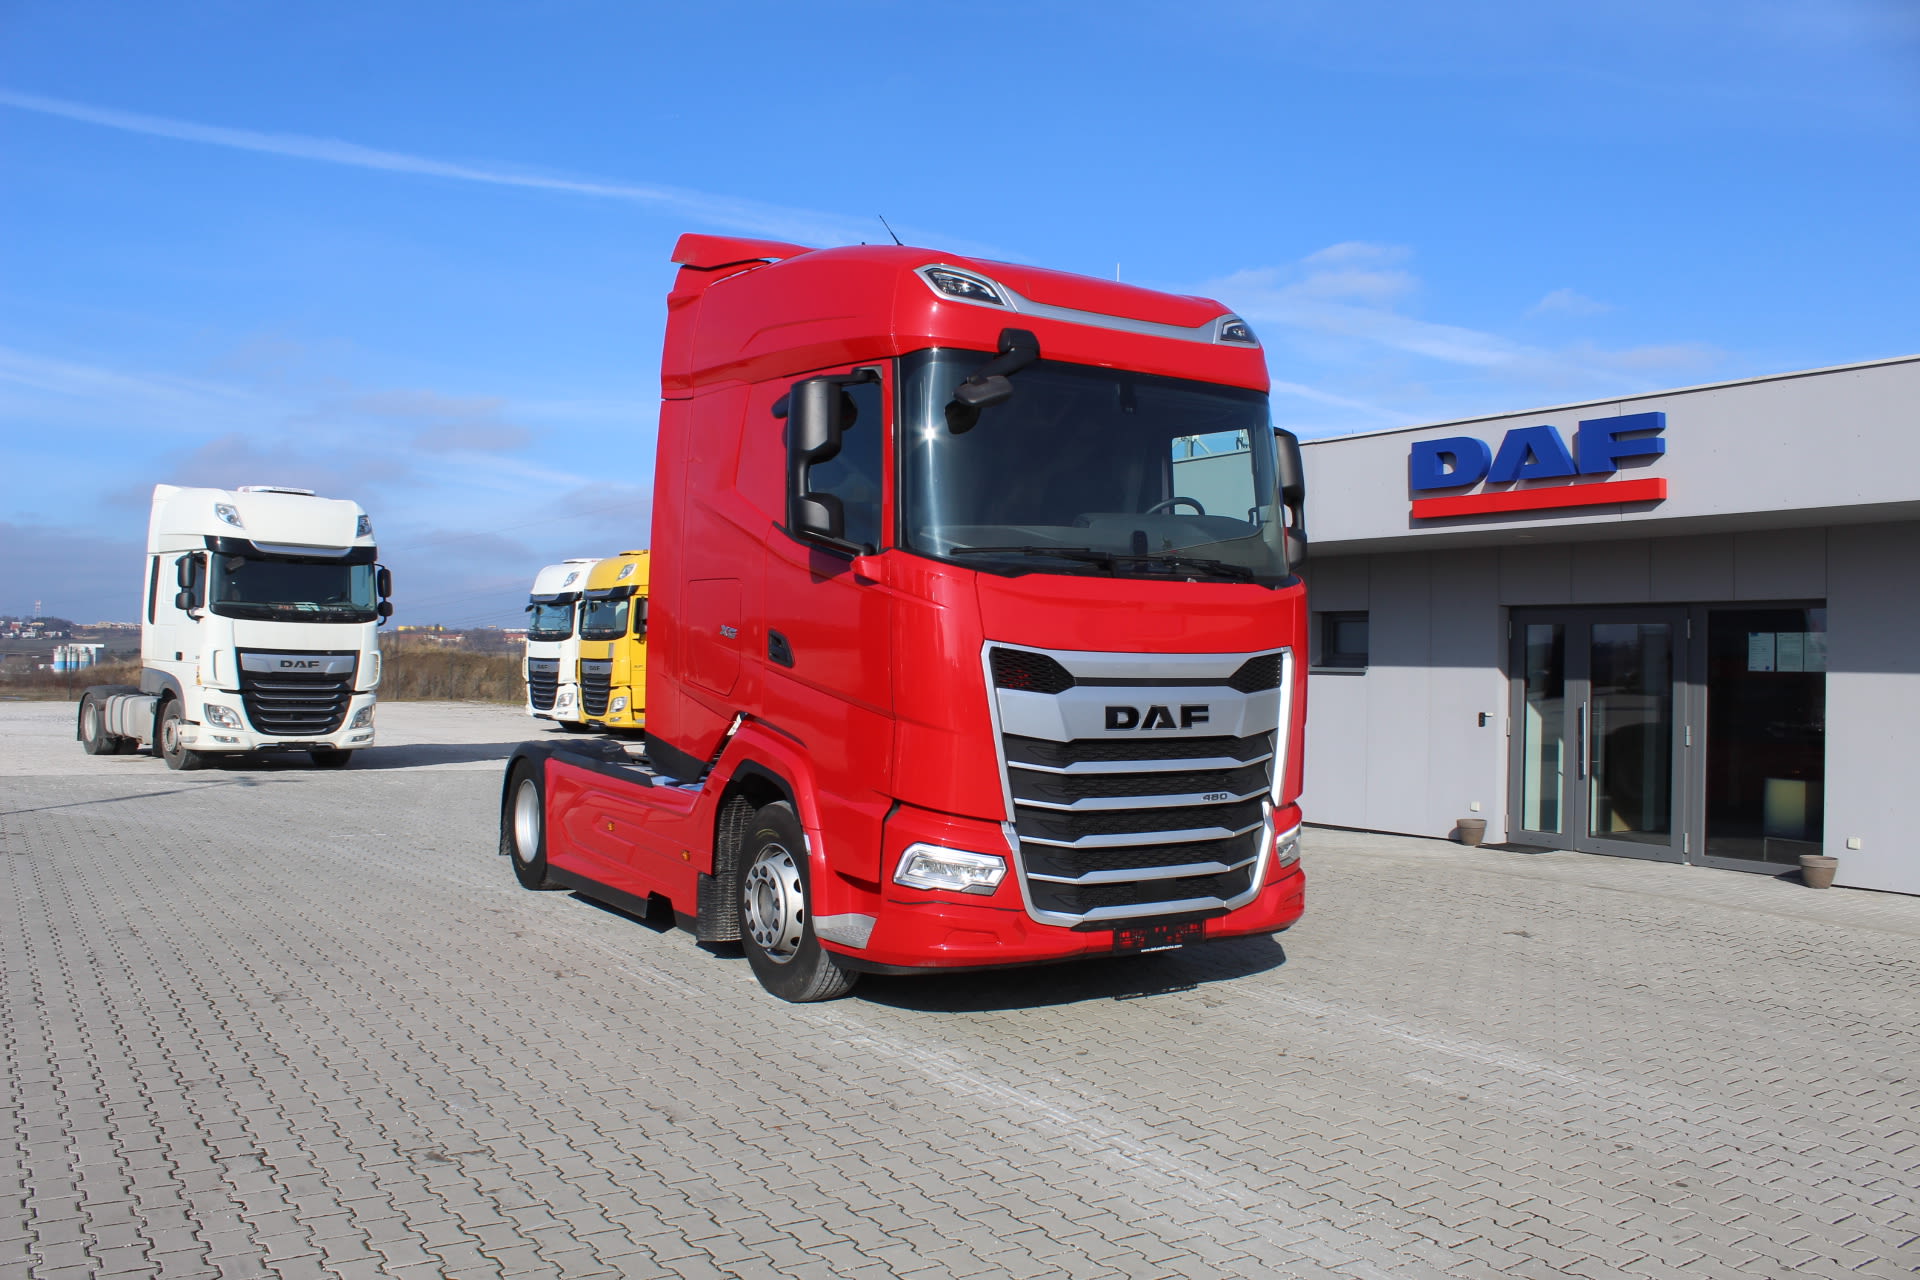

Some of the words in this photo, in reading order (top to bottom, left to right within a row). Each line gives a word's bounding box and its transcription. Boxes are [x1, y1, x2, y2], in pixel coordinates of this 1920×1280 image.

[1411, 411, 1666, 490] DAF
[280, 660, 320, 668] DAF
[1104, 704, 1209, 730] DAF
[1202, 793, 1228, 801] 480
